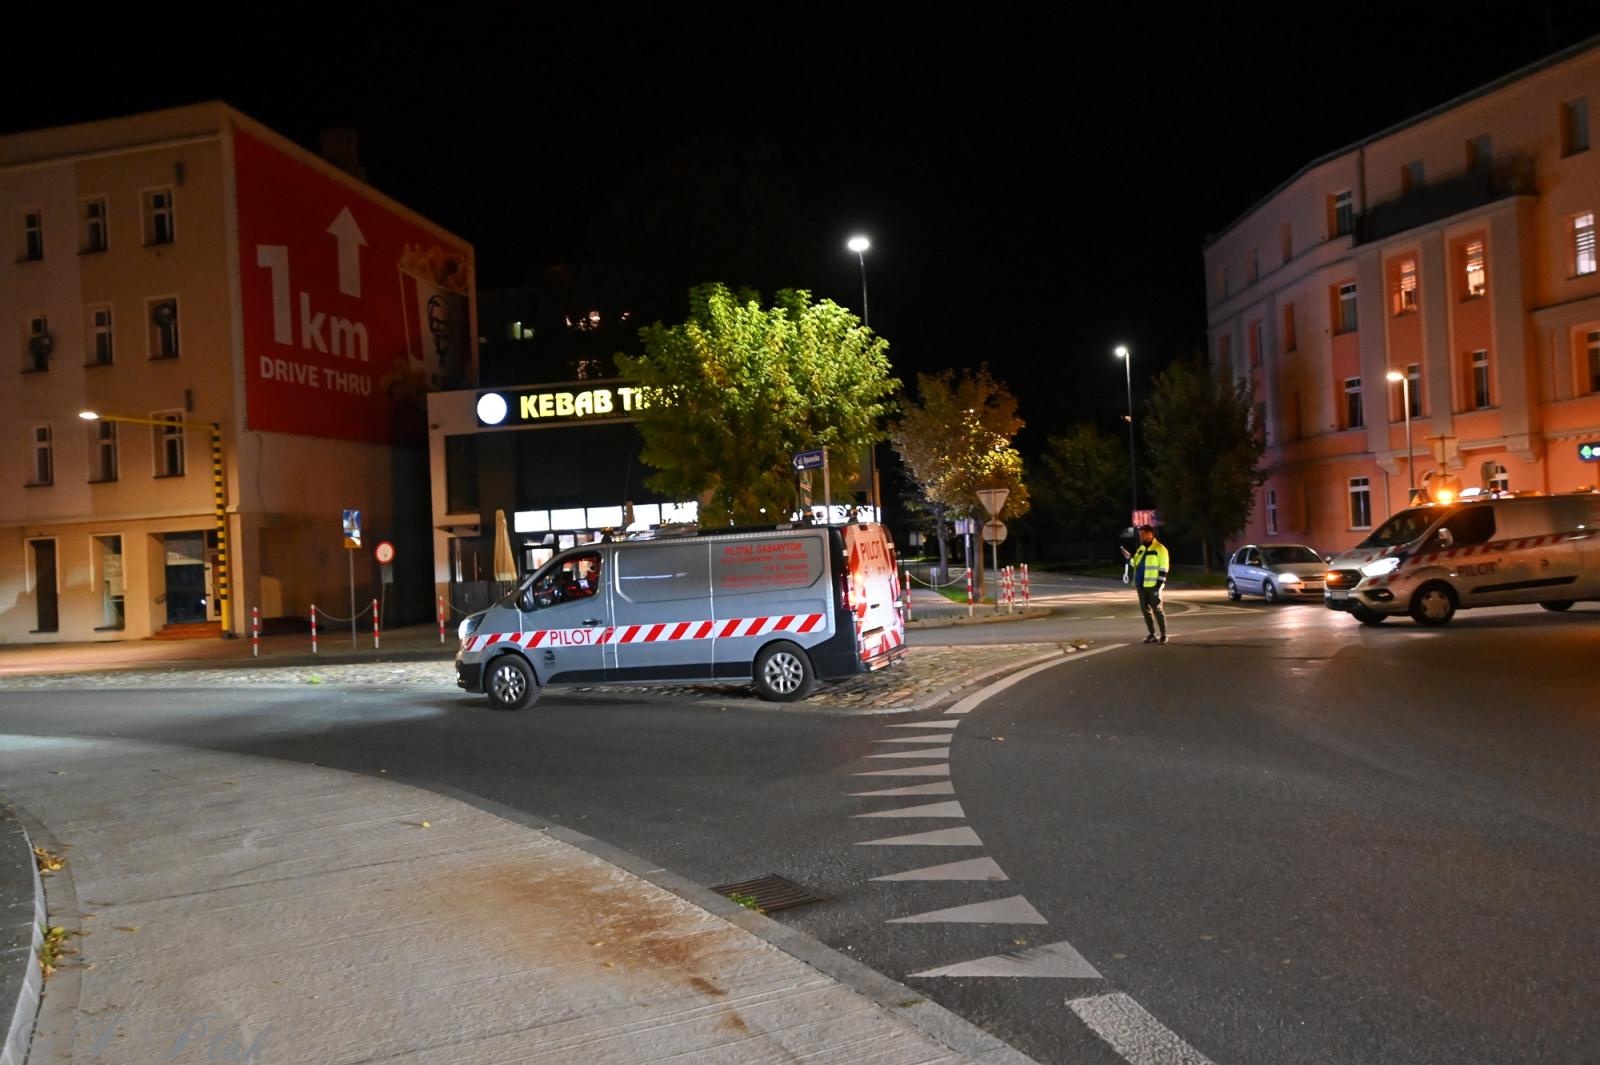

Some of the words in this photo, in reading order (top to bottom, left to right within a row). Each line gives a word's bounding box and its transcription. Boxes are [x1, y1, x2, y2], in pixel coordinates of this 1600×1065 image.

[259, 355, 319, 387] DRIVE
[323, 368, 372, 396] THRU
[520, 389, 613, 419] KEBAB
[860, 541, 882, 562] PILOT
[1457, 562, 1496, 577] PILOT
[550, 629, 592, 645] PILOT
